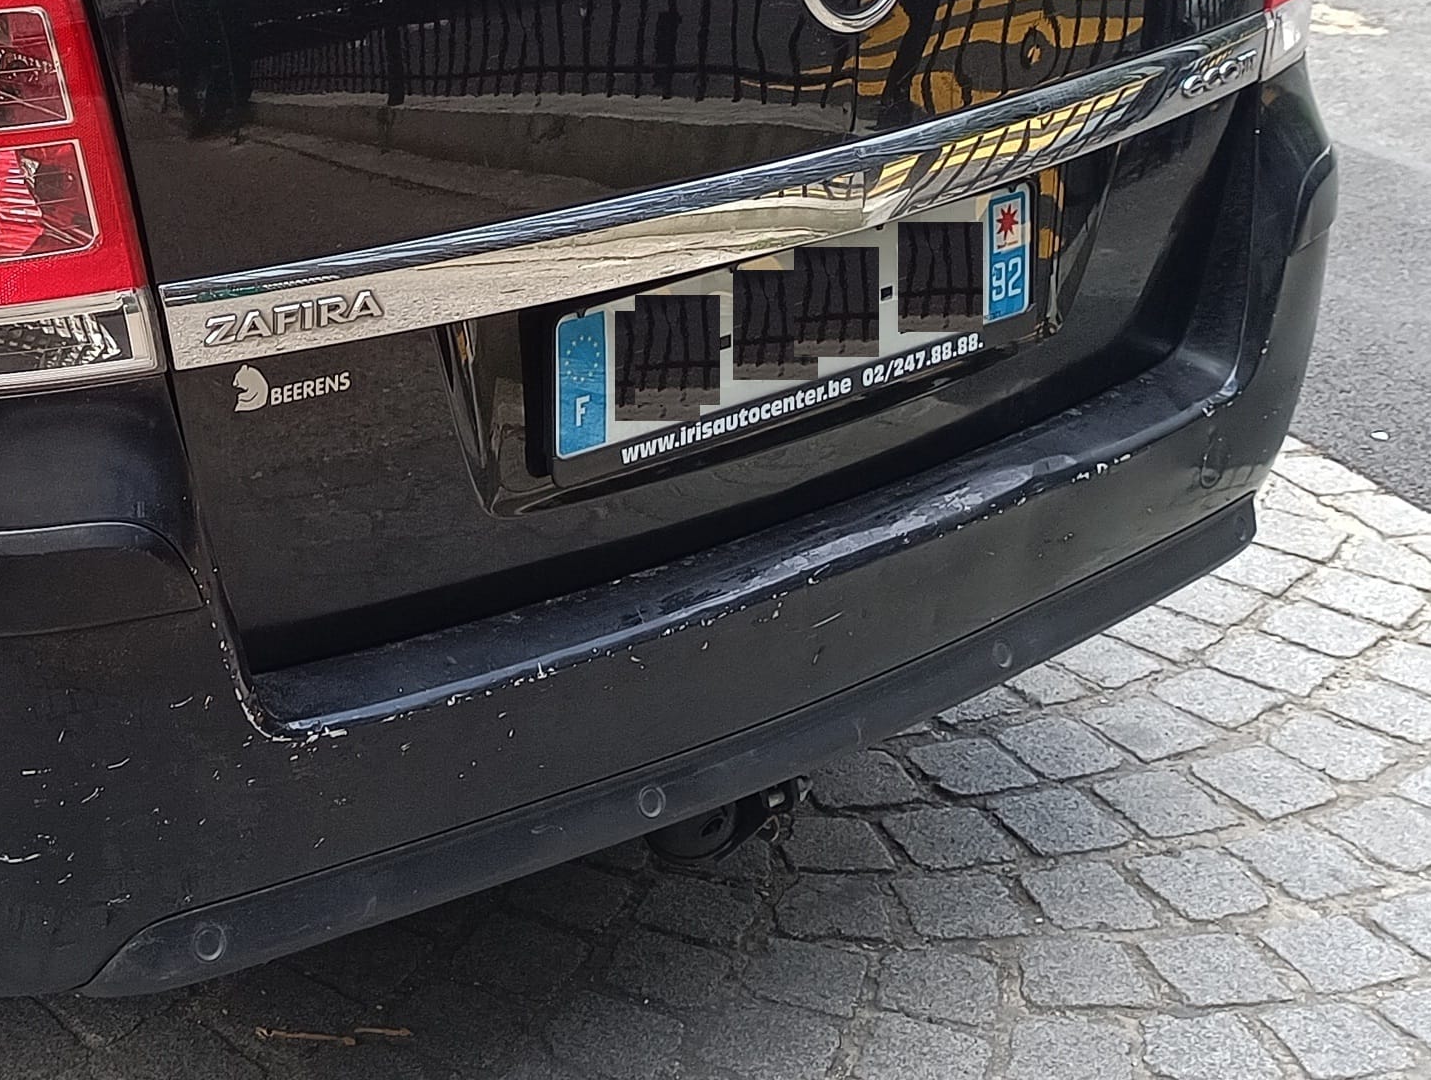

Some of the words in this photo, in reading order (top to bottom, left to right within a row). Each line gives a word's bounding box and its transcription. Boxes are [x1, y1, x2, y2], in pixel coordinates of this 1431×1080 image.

[991, 256, 1022, 301] 92
[205, 290, 384, 347] ZAFIRA
[271, 371, 351, 406] BEERENS
[574, 394, 591, 427] F
[621, 375, 852, 464] www.irisautocenter.be
[862, 332, 984, 387] 02/247.88.88.
